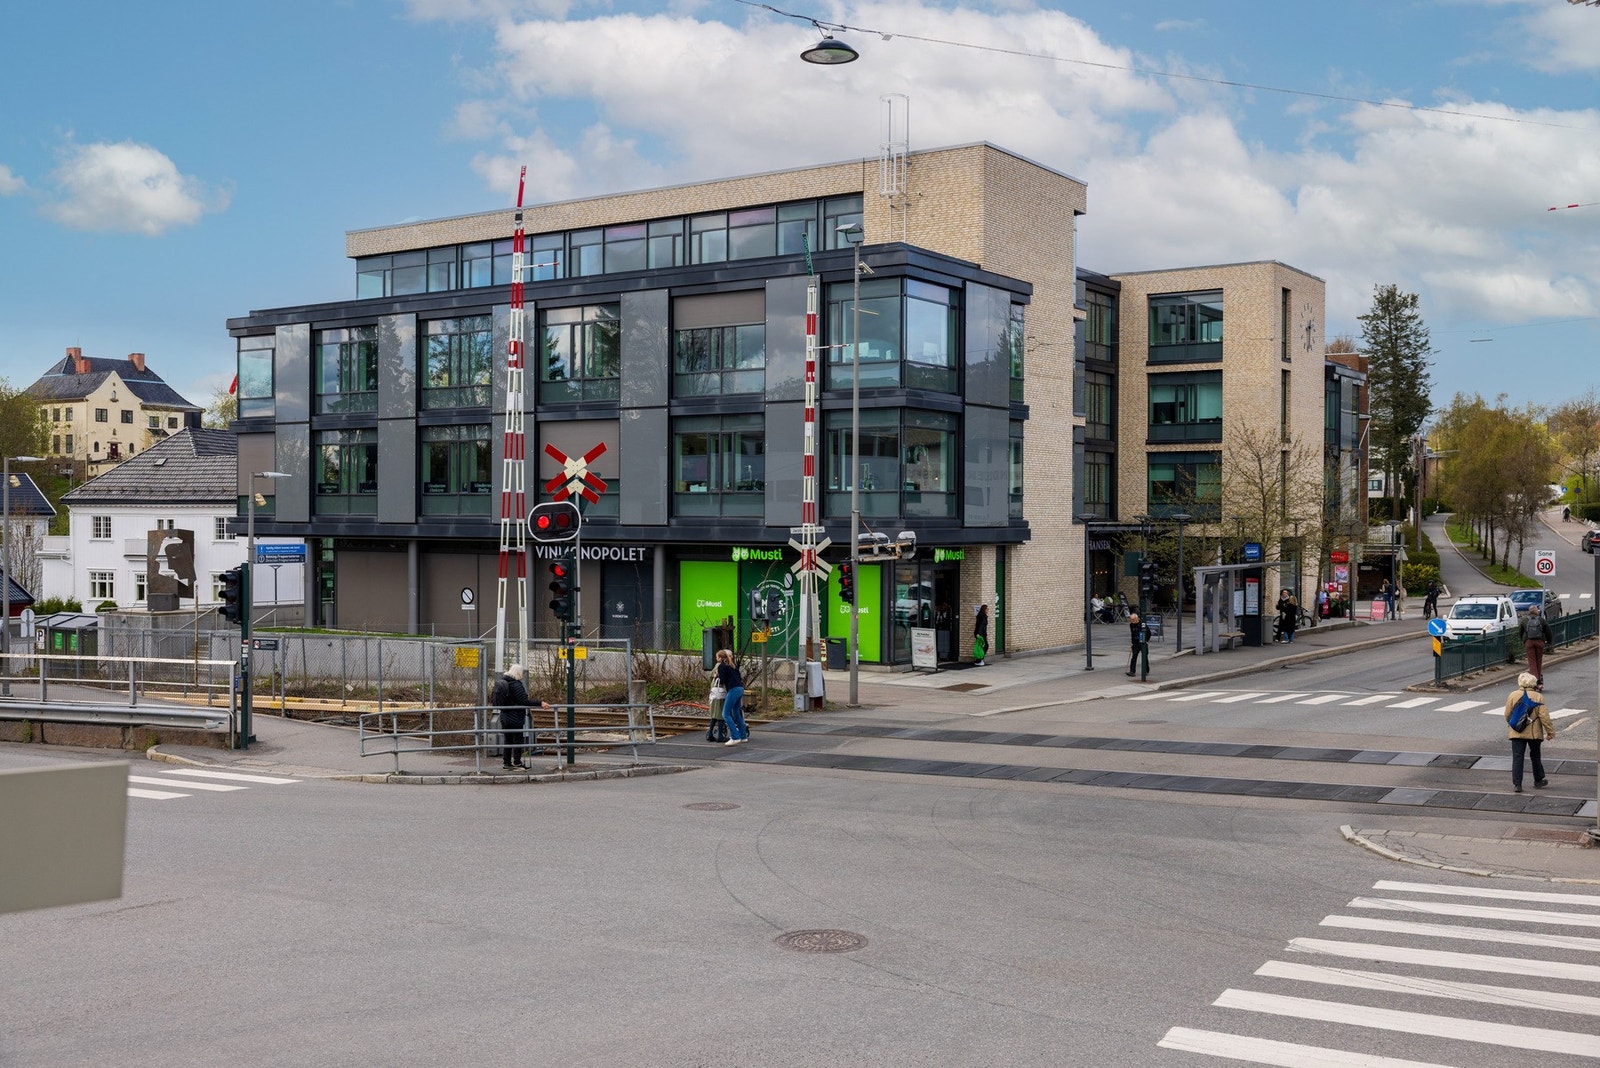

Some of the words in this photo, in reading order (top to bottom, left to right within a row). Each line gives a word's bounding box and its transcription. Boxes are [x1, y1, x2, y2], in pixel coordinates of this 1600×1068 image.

[750, 548, 783, 560] Musti
[945, 548, 965, 560] Musti
[1540, 562, 1550, 570] 30
[706, 600, 722, 608] Musti
[38, 630, 43, 641] P
